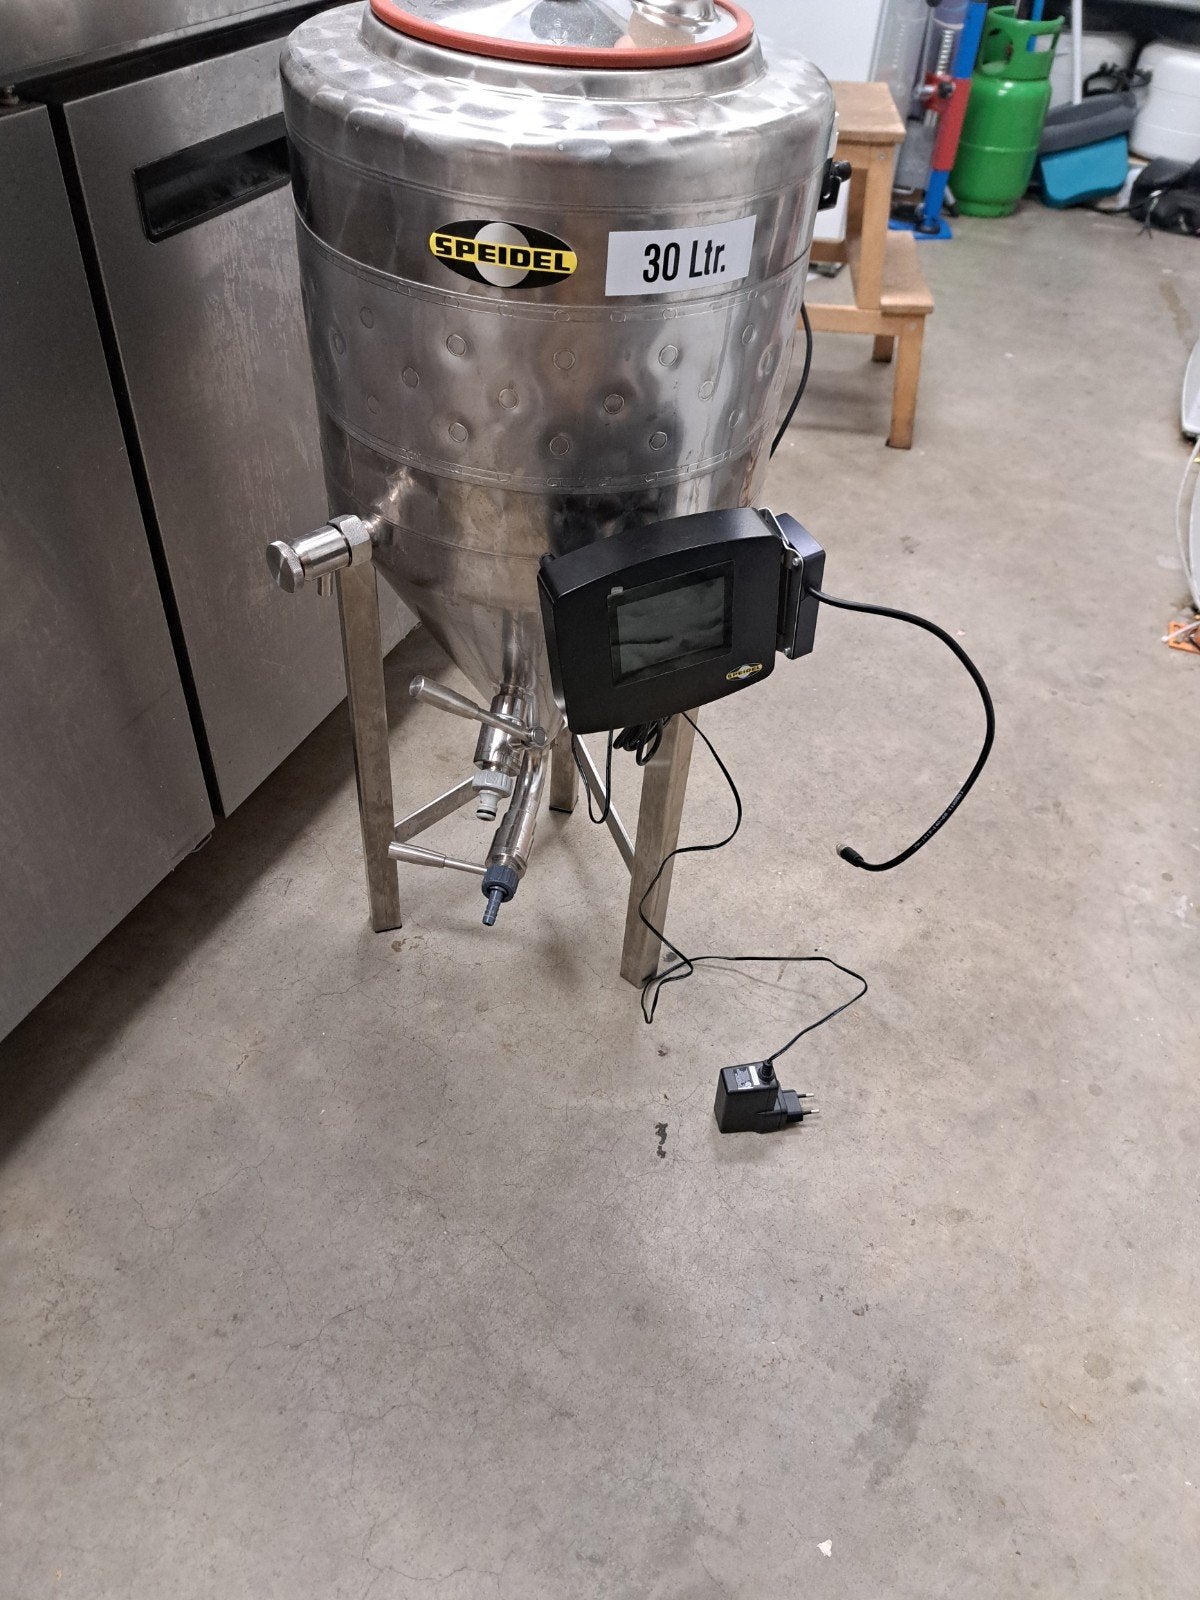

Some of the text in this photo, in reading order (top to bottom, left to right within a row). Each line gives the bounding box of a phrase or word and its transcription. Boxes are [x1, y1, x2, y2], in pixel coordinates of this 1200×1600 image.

[435, 236, 570, 272] SPEIDEL
[642, 239, 726, 283] 30 Ltr.
